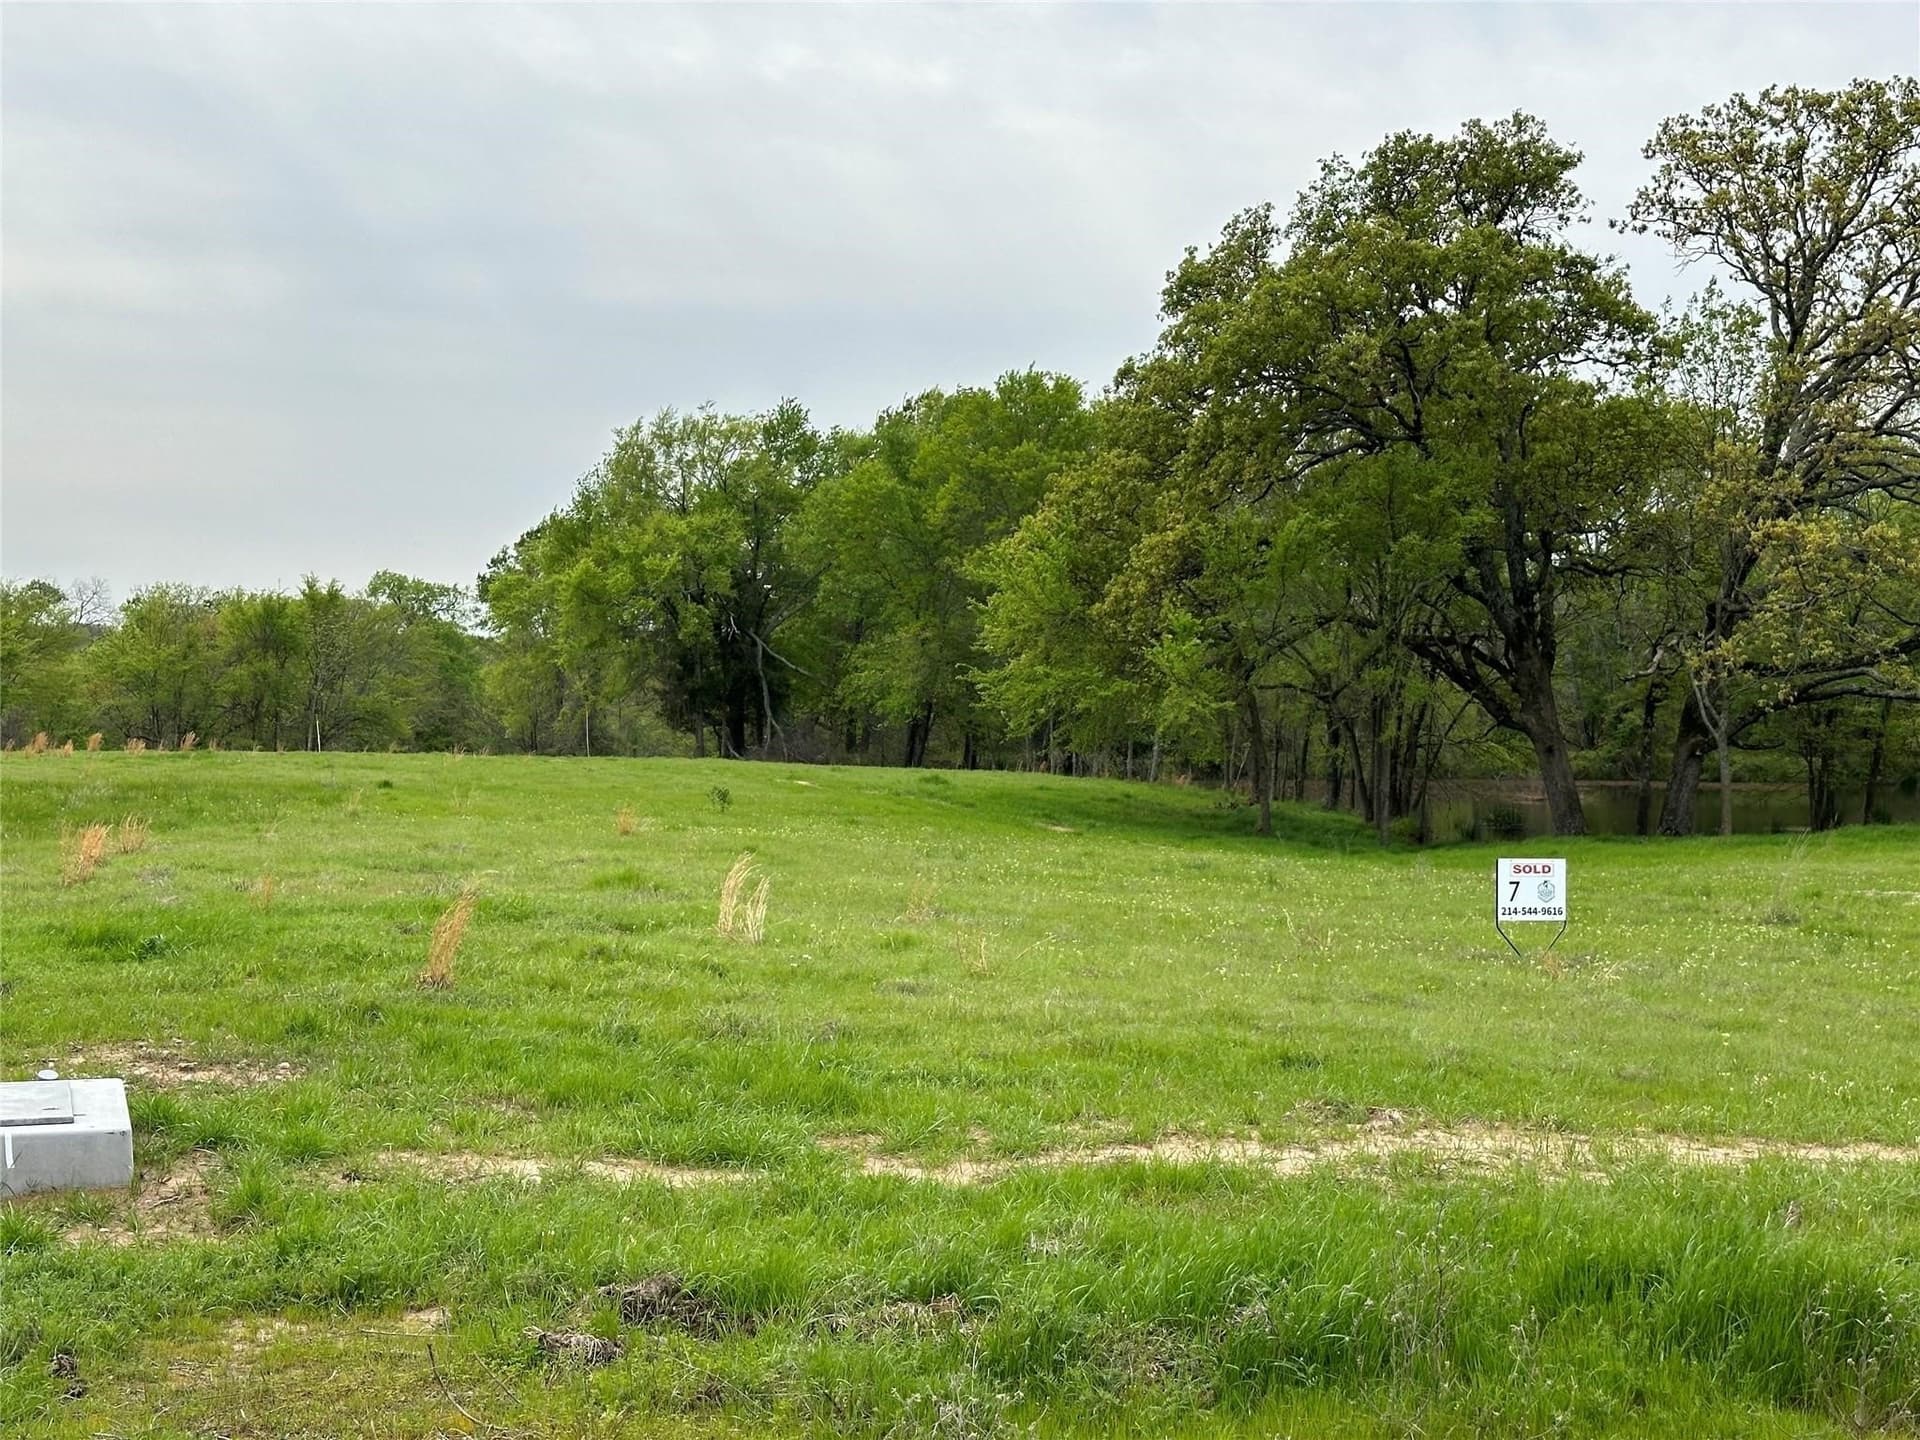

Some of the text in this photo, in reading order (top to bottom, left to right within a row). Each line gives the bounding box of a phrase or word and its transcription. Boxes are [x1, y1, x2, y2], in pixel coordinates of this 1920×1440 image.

[1513, 864, 1551, 874] SOLD
[1509, 881, 1520, 902] 7
[1501, 906, 1563, 916] 214-544-9616
